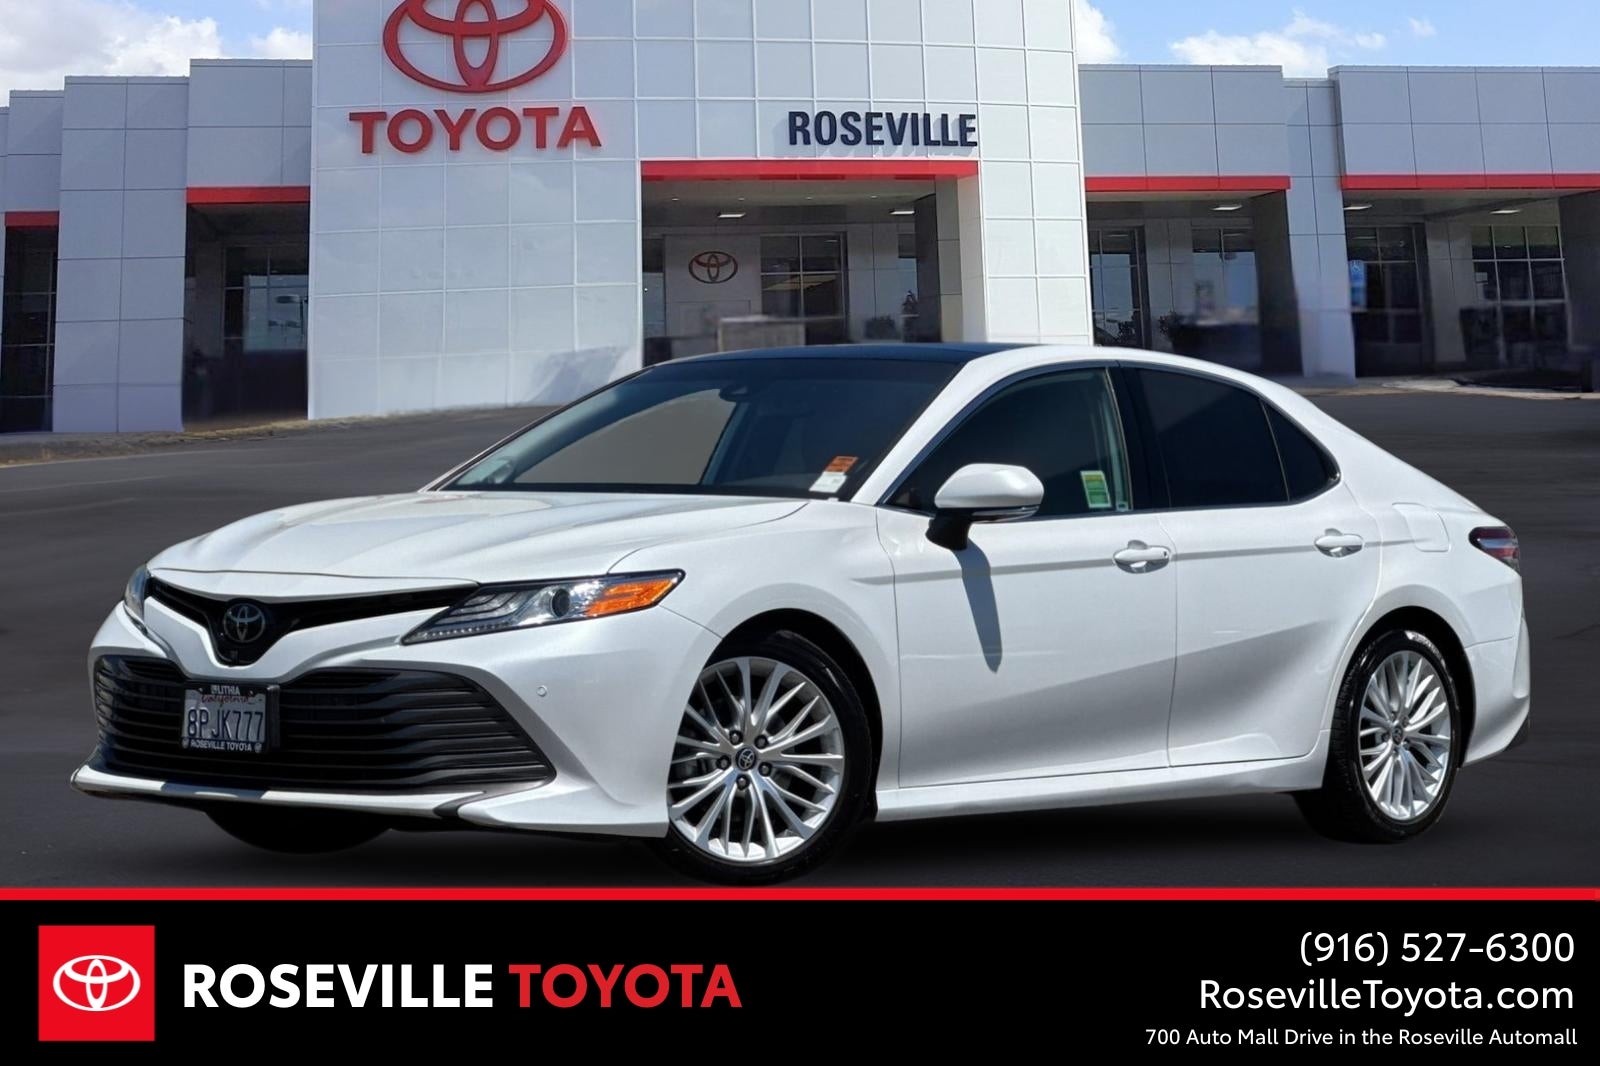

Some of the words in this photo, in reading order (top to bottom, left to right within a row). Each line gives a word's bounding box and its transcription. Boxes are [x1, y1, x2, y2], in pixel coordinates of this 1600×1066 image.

[349, 106, 602, 154] TOYOTA
[788, 110, 979, 148] ROSEVILLE
[187, 708, 264, 742] 8PJK777
[190, 740, 225, 750] ROSEVILLE
[226, 741, 252, 752] TOYOTA
